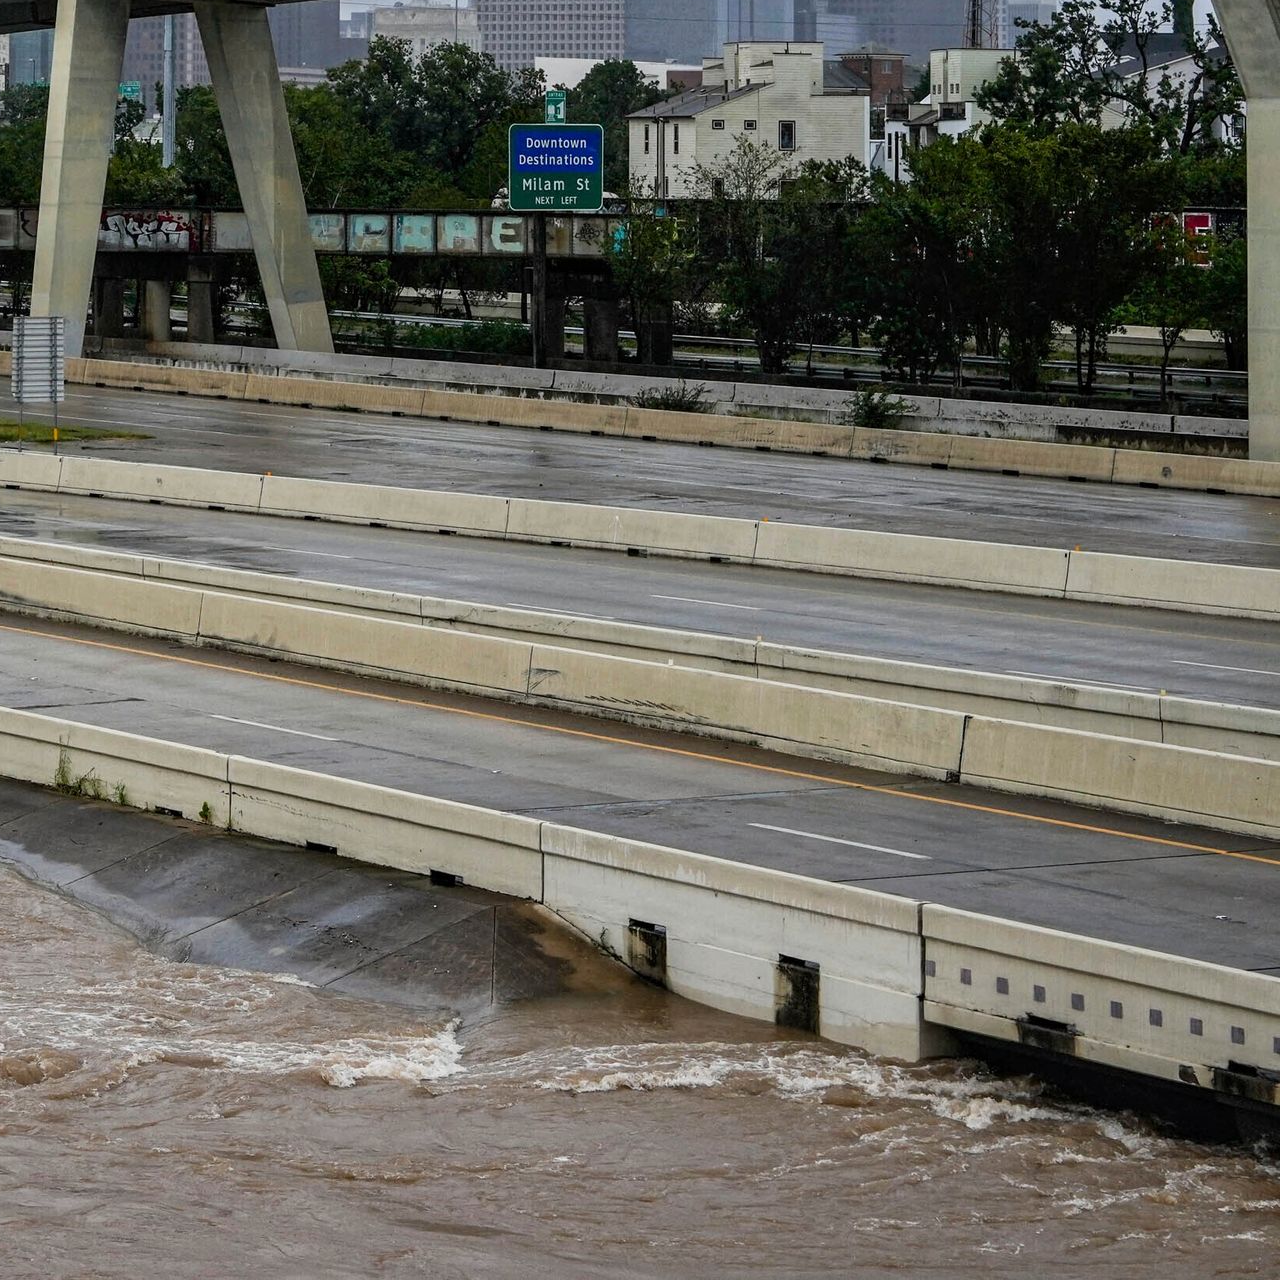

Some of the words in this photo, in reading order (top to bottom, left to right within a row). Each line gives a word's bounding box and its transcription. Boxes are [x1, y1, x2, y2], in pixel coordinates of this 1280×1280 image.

[526, 137, 587, 148] Downtown
[519, 153, 594, 165] Destinations
[522, 177, 565, 191] Milam
[576, 178, 590, 191] St
[535, 196, 554, 205] NEXT
[561, 196, 577, 205] LEFT
